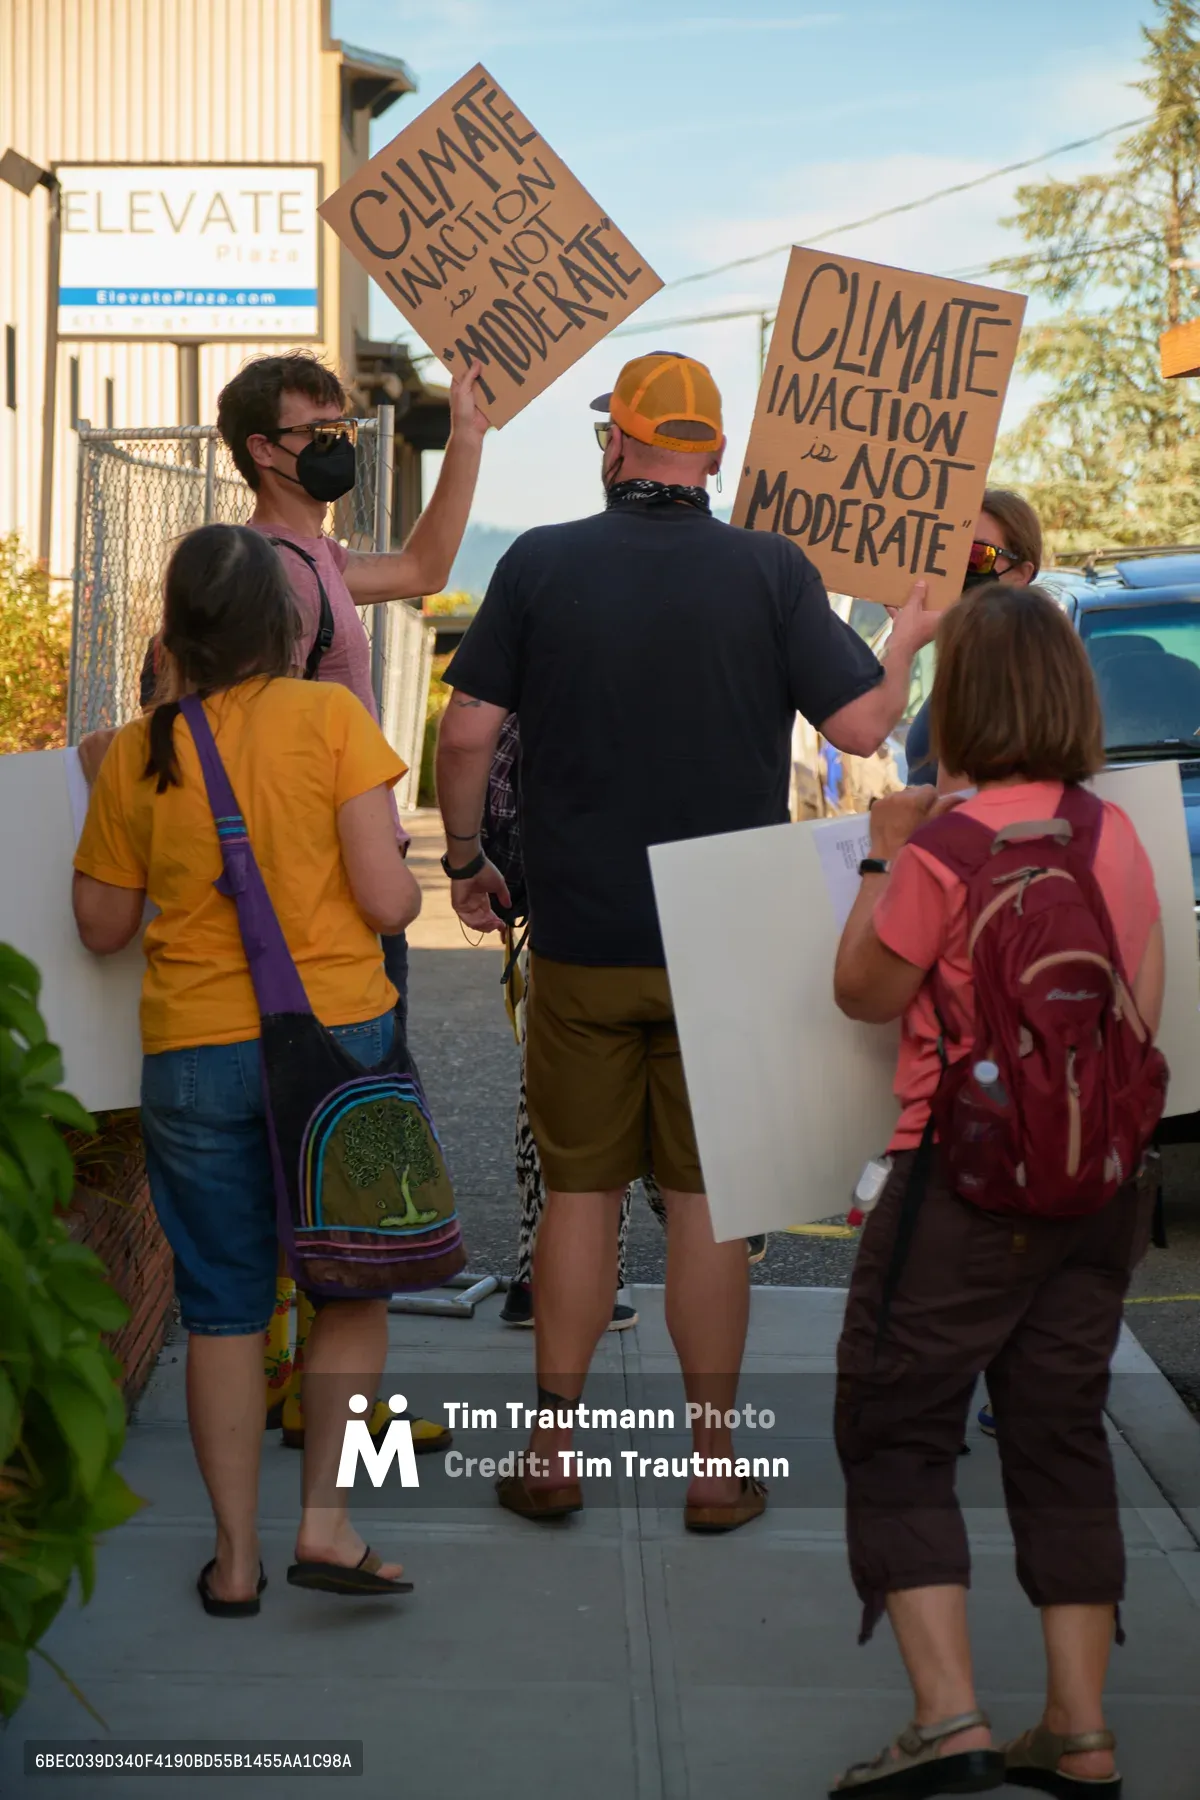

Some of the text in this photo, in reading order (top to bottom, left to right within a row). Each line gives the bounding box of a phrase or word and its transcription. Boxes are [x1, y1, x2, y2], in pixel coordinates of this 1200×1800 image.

[62, 191, 304, 234] ELEVATE
[350, 77, 537, 260] CLIMATE
[385, 157, 555, 309] INACTION
[444, 201, 564, 317] is NOT
[791, 262, 1012, 400] CLIMATE
[766, 365, 968, 456] INACTION
[800, 437, 975, 510] is NOT
